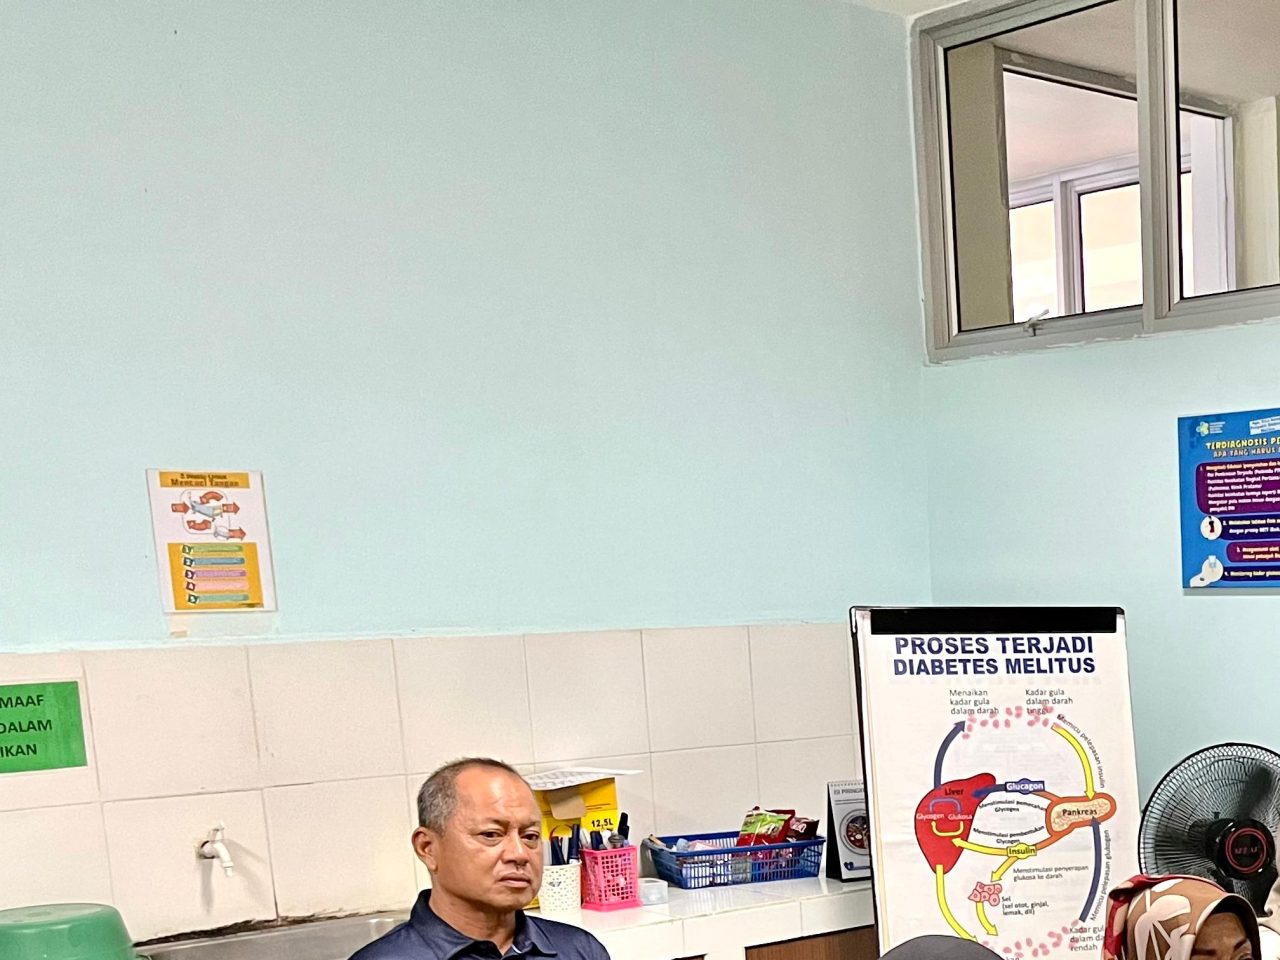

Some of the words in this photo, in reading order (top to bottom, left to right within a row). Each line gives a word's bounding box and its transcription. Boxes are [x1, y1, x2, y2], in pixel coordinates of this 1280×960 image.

[1206, 437, 1267, 450] TERDIAGNOSIS
[1213, 449, 1227, 458] APA
[894, 636, 989, 654] PROSES
[996, 636, 1094, 654] TERJADI
[894, 658, 999, 676] DIABETES
[1005, 657, 1096, 675] MELITUS
[949, 689, 988, 697] Menaikan
[1025, 689, 1047, 697] Kadar
[1049, 689, 1065, 698] gula
[0, 694, 44, 708] MAAF
[950, 698, 971, 706] kadar
[973, 698, 990, 707] gula
[1026, 697, 1049, 705] dalam
[1051, 697, 1073, 705] darah
[951, 707, 975, 715] dalam
[977, 707, 999, 715] darah
[1027, 707, 1049, 715] tinggi
[0, 719, 52, 734] DALAM
[1057, 713, 1081, 734] Memicu
[1080, 732, 1101, 765] pelepasan
[1006, 782, 1044, 791] Glucagon
[944, 787, 965, 796] Liver
[1062, 808, 1098, 816] Pankreas
[916, 813, 945, 821] Glycogen
[591, 818, 614, 829] 12,5L
[1014, 874, 1036, 882] glukosa
[1090, 895, 1105, 922] Memicu
[1101, 861, 1111, 894] pelepasan
[1002, 902, 1013, 910] (sel
[1031, 901, 1049, 909] ginjal,
[1092, 925, 1104, 934] gul
[1070, 935, 1094, 943] dalam
[1070, 943, 1098, 951] rendah
